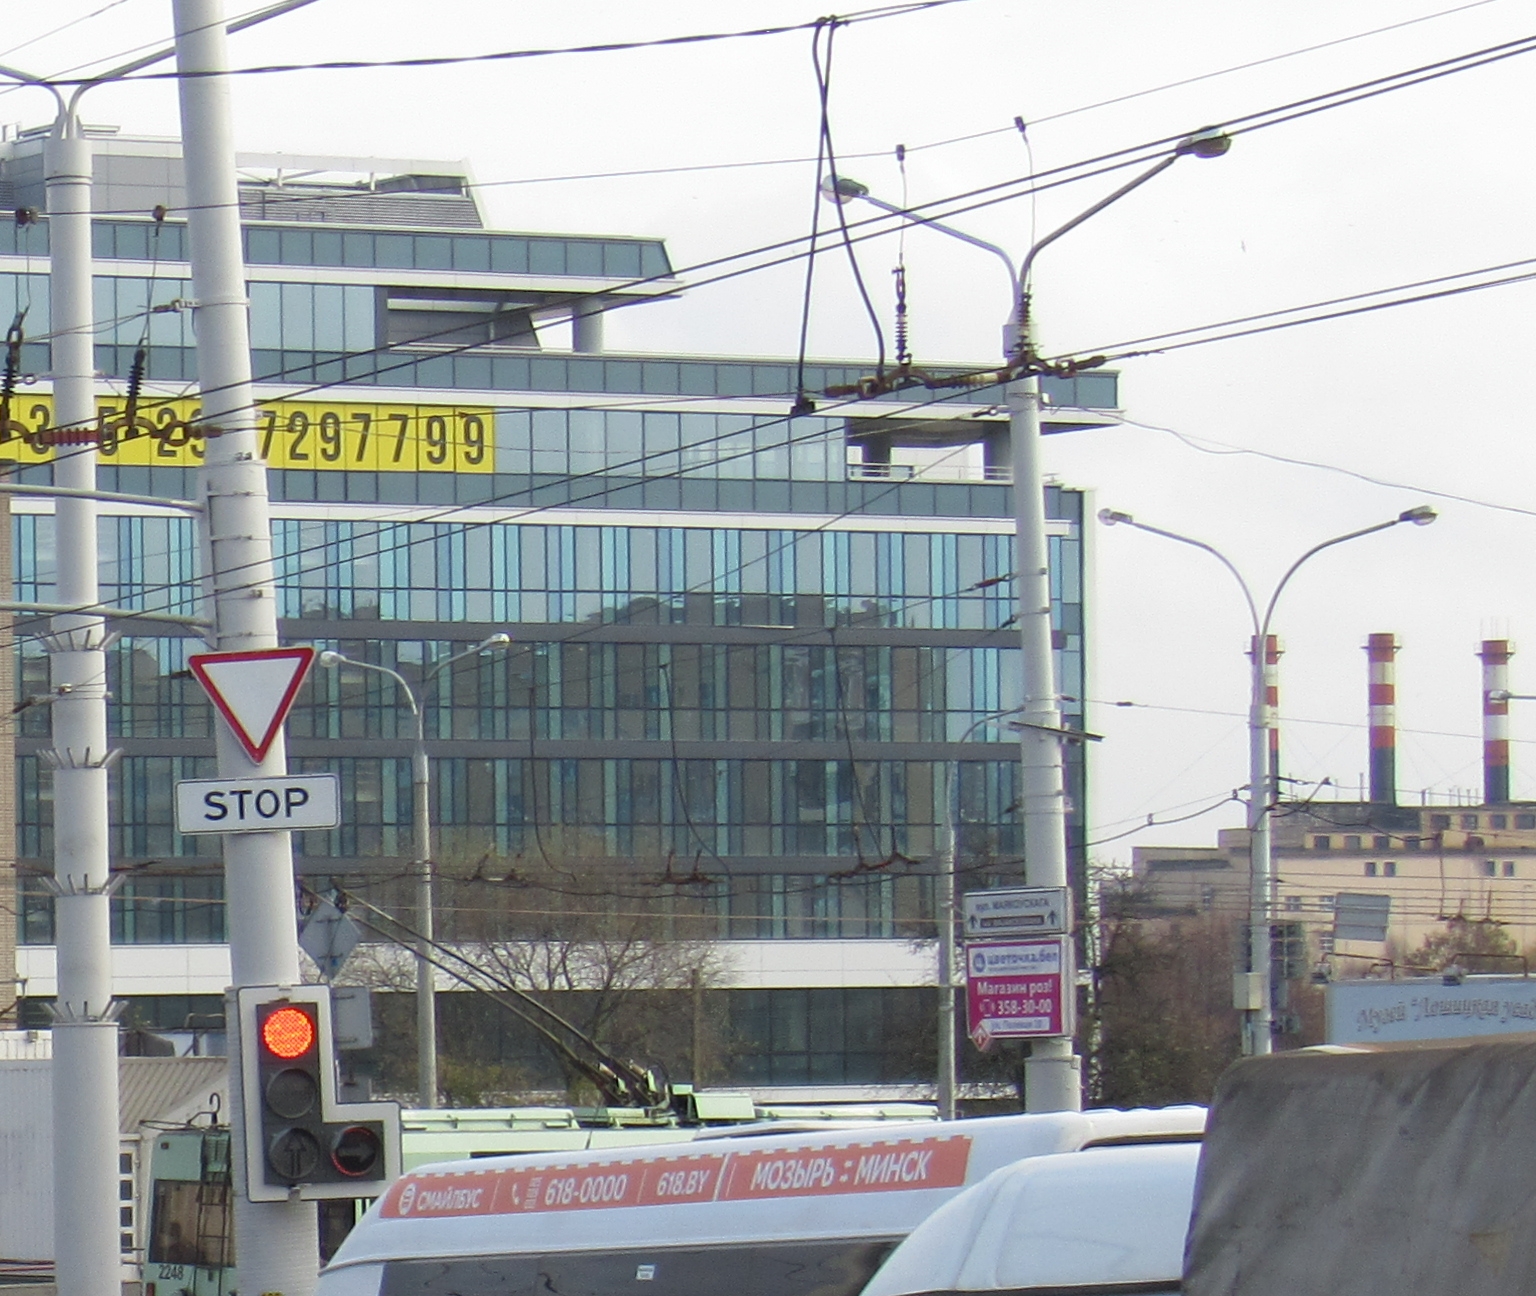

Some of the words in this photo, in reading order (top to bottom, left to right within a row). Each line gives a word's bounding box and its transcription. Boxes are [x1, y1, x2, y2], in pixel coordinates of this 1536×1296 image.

[256, 409, 485, 465] 7297799
[204, 787, 309, 821] STOP
[977, 981, 1027, 996] Магазин
[1029, 979, 1053, 998] роз!
[997, 998, 1053, 1016] 358-30-00
[417, 1186, 484, 1211] СМАЙЛБУС
[545, 1174, 627, 1206] 618-0000
[656, 1169, 710, 1197] 618.BY
[750, 1157, 835, 1191] МОЗЫРЬ
[854, 1150, 933, 1185] МИНСК
[159, 1264, 184, 1280] 2248
